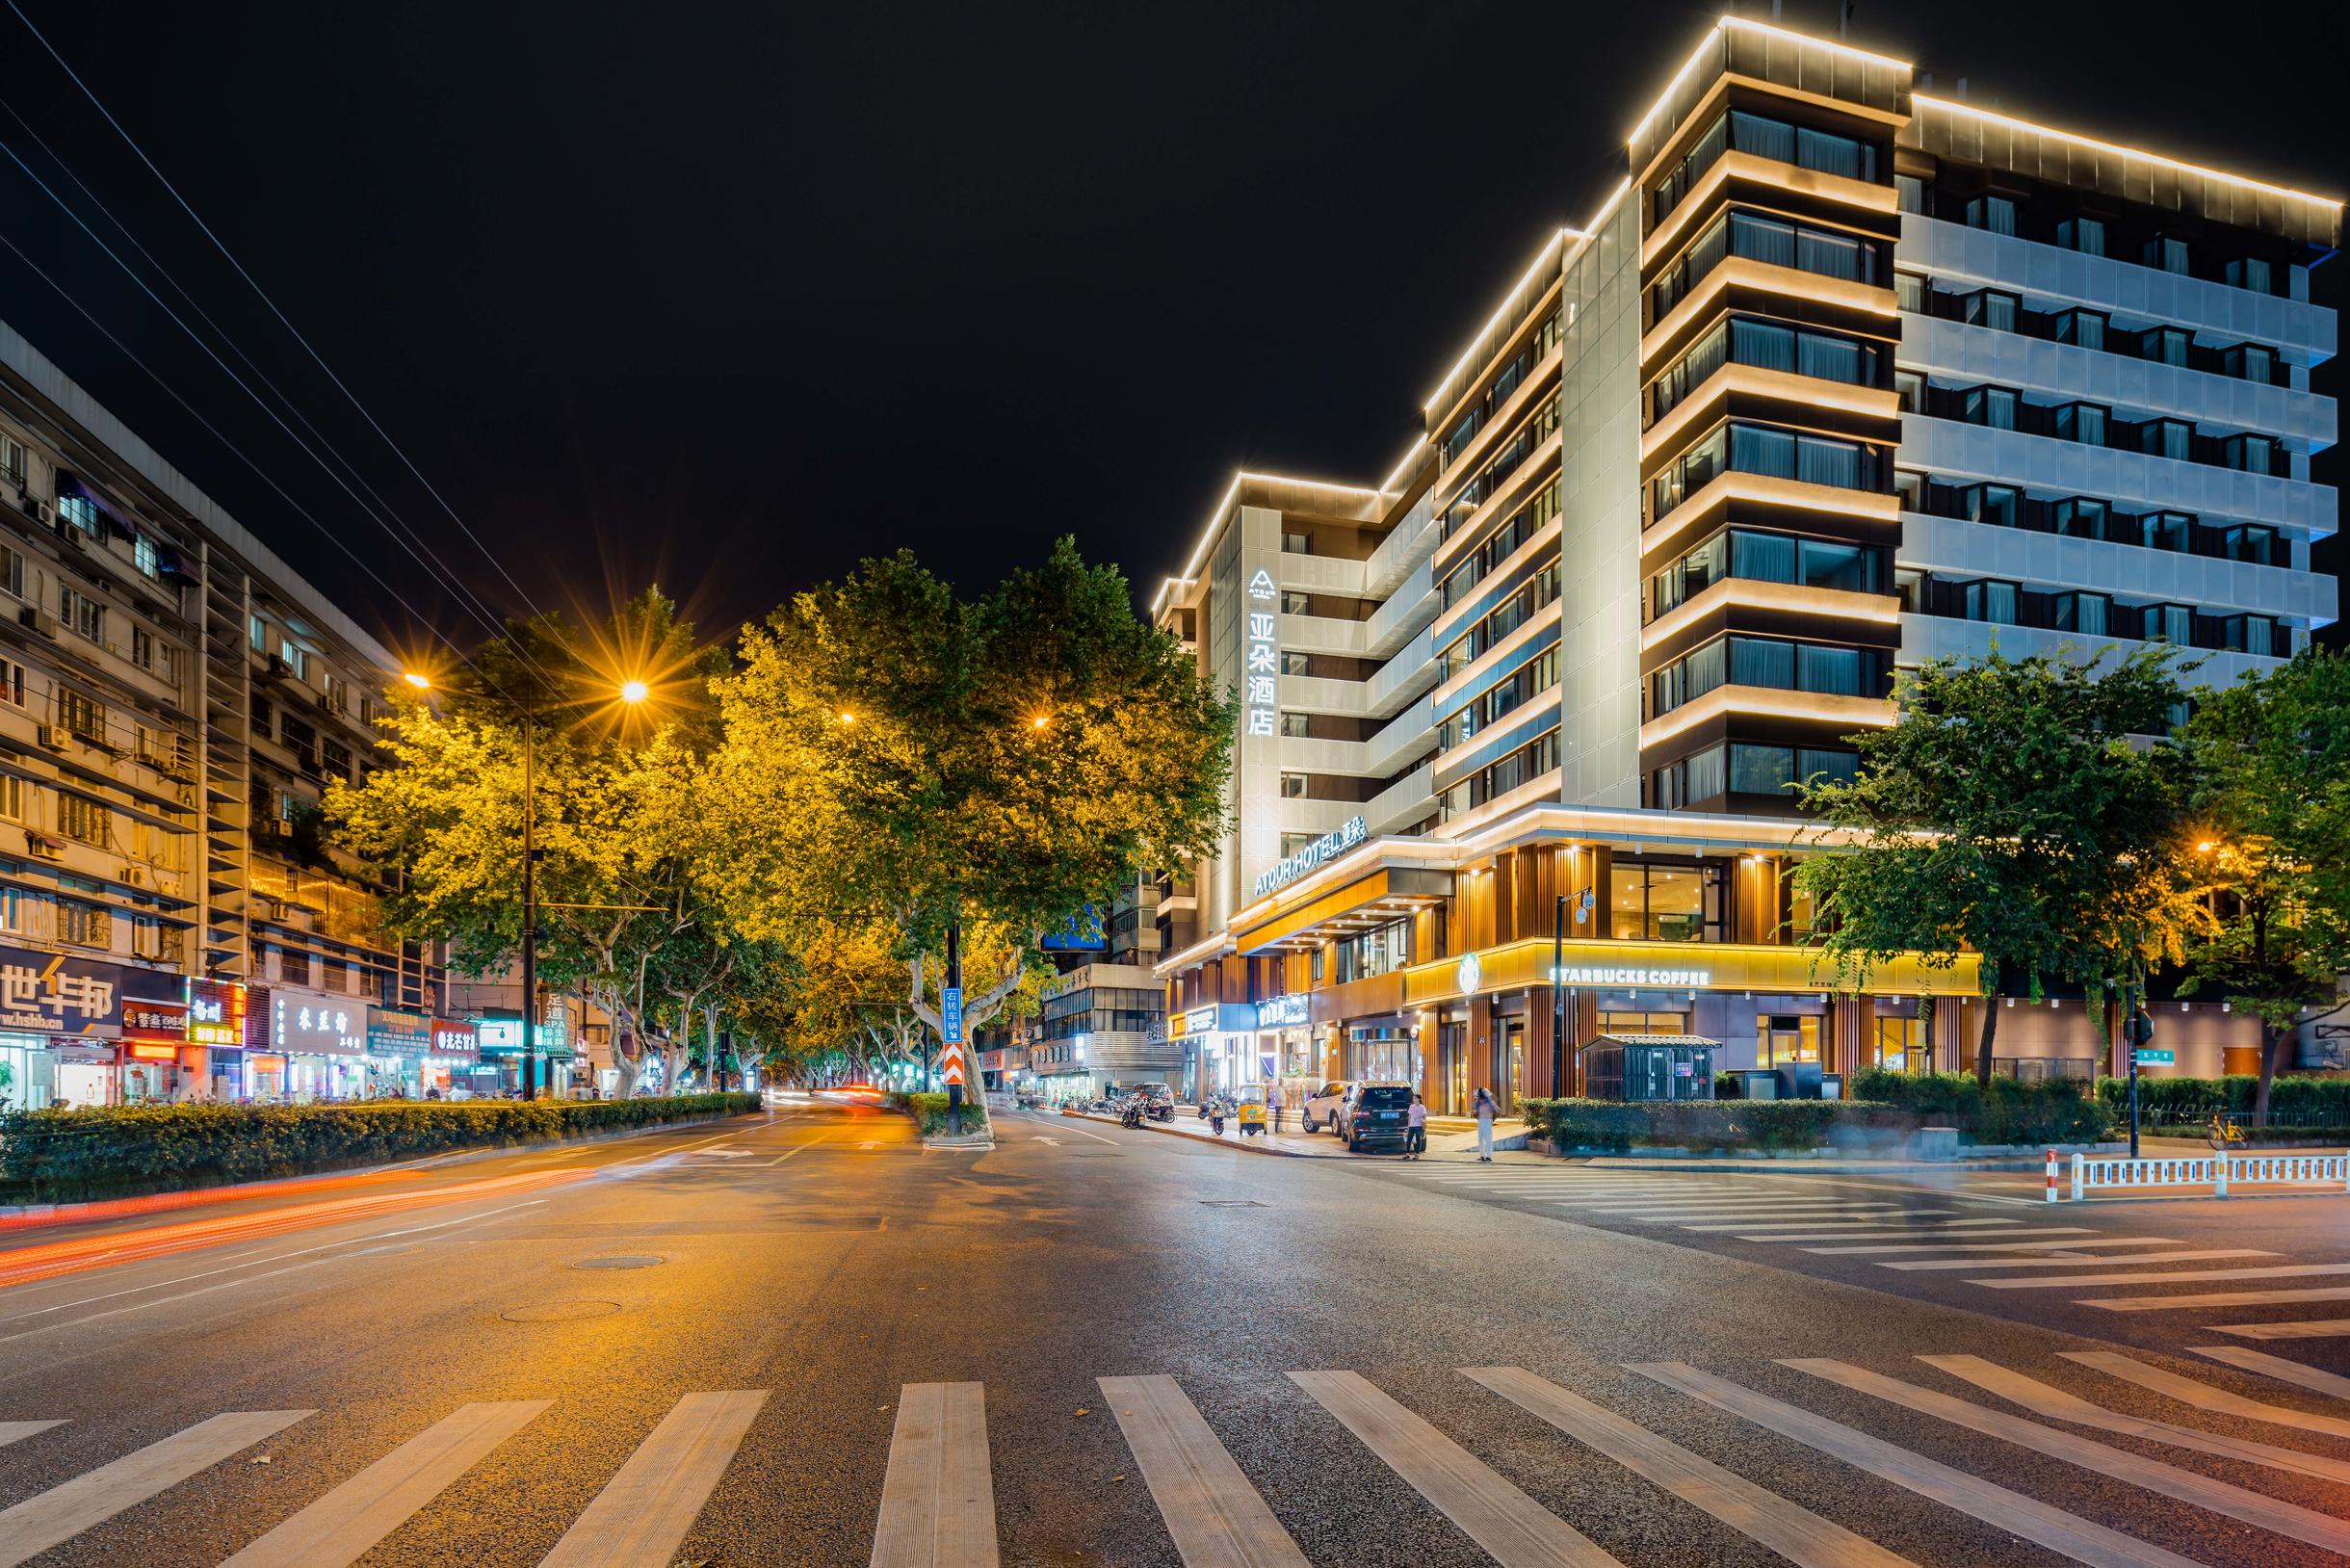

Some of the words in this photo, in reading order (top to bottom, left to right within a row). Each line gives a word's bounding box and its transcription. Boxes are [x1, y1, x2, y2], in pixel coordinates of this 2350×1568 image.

[1248, 613, 1275, 737] 亚朵酒店
[1255, 858, 1295, 896] ATOUR
[1294, 831, 1342, 874] HOTEL
[1549, 968, 1646, 984] STARBUCKS
[1649, 970, 1709, 986] COFFEE
[545, 993, 563, 1019] 足道
[947, 991, 958, 1032] 右转车辆
[0, 1012, 64, 1032] w.hshb.cn
[544, 1020, 565, 1029] SPA
[542, 1037, 565, 1046] 棋牌
[544, 1029, 564, 1037] 养生
